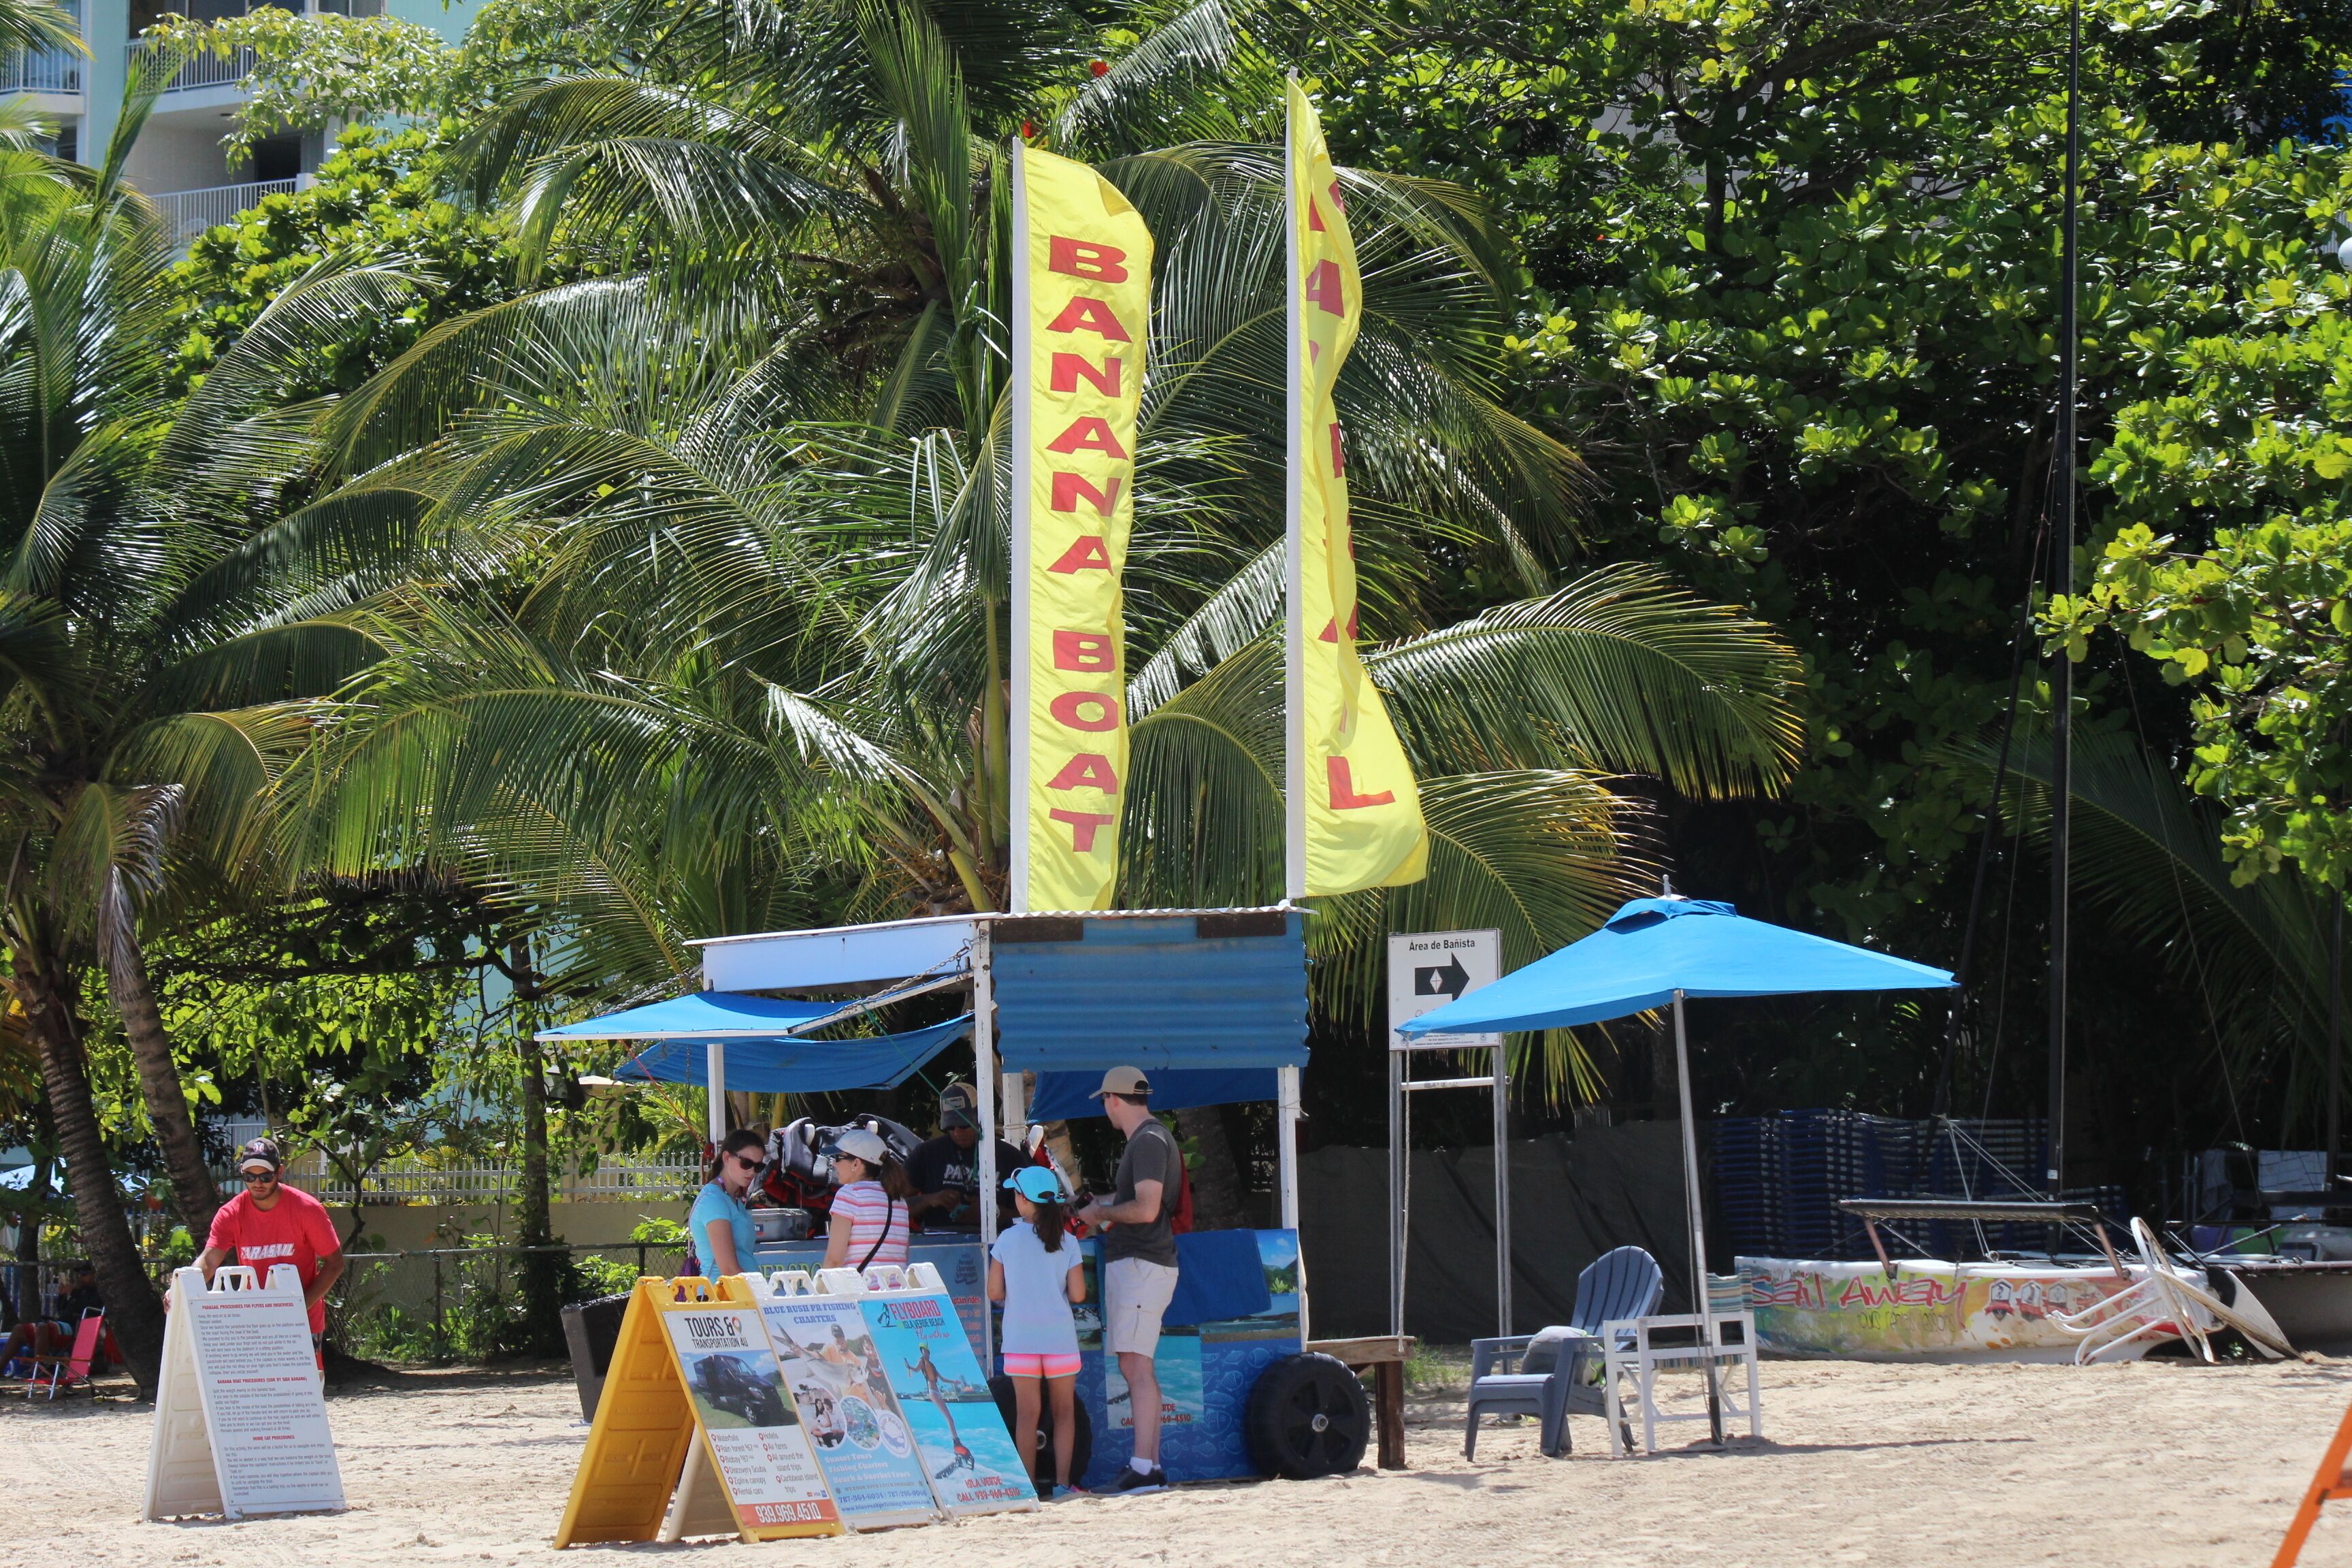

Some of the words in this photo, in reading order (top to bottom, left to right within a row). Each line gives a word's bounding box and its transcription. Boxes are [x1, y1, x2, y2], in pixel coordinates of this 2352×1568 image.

[1045, 235, 1132, 577] BANANA
[1045, 630, 1119, 852] BOAT
[1409, 940, 1428, 951] Área
[1431, 941, 1441, 949] de
[1443, 939, 1475, 949] Bañista
[967, 1296, 980, 1304] rides
[1752, 1272, 1827, 1309] Sail
[1839, 1275, 1967, 1331] Away
[763, 1306, 786, 1314] BLUE
[786, 1305, 809, 1313] RUSH
[809, 1304, 822, 1312] PR
[822, 1303, 856, 1311] FISHING
[888, 1300, 942, 1320] FLYBOARD
[794, 1314, 837, 1324] CHARTERS
[902, 1320, 913, 1329] ISLA
[913, 1319, 930, 1328] VERDE
[930, 1318, 946, 1327] BEACH
[684, 1316, 725, 1338] TOURS
[723, 1316, 736, 1336] &
[691, 1337, 740, 1349] TRANSPORTATION
[740, 1337, 749, 1348] 4U
[1162, 1403, 1176, 1412] RDE
[716, 1434, 740, 1442] Waterfalls
[824, 1454, 851, 1463] Sunset
[850, 1452, 872, 1461] Tours
[728, 1466, 752, 1475] Discovery
[790, 1463, 802, 1471] trips
[828, 1463, 858, 1473] Fishing
[858, 1461, 889, 1470] Charters
[733, 1477, 749, 1485] Zipline
[780, 1474, 804, 1482] Caribbean
[832, 1475, 856, 1484] Beach
[863, 1472, 891, 1480] Snorkel
[890, 1470, 911, 1478] Tours
[964, 1479, 981, 1488] ISLA
[981, 1476, 1002, 1486] VERDE
[784, 1485, 796, 1494] trips
[957, 1492, 975, 1502] CALL
[975, 1486, 1020, 1500] 939-969-4510
[755, 1502, 822, 1523] 939.969.4510
